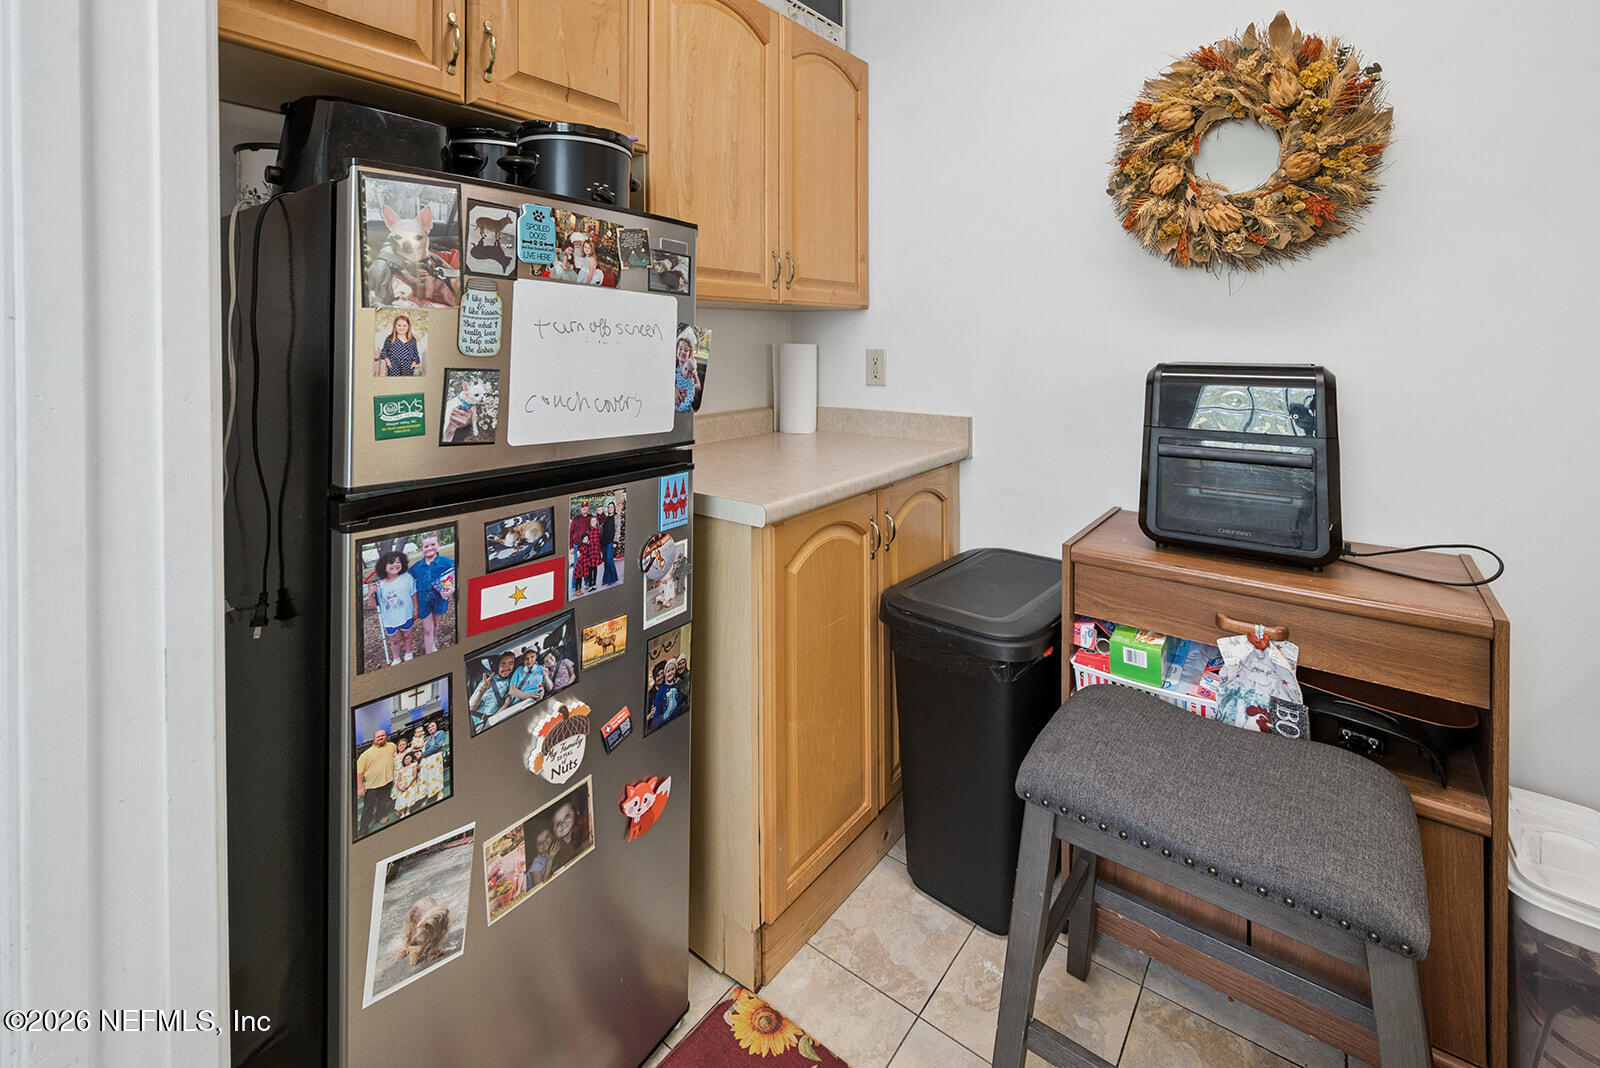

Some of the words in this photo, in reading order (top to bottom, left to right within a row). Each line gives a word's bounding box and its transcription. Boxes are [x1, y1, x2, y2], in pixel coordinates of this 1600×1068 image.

[525, 223, 550, 233] SPOILED
[529, 232, 547, 240] DOGS
[523, 251, 536, 260] LIVE
[537, 253, 551, 261] HERE
[534, 319, 585, 339] turn
[590, 318, 611, 337] off
[616, 323, 663, 341] screen
[378, 398, 423, 416] JOEY'S
[524, 391, 590, 413] couch
[551, 759, 578, 779] Nuts
